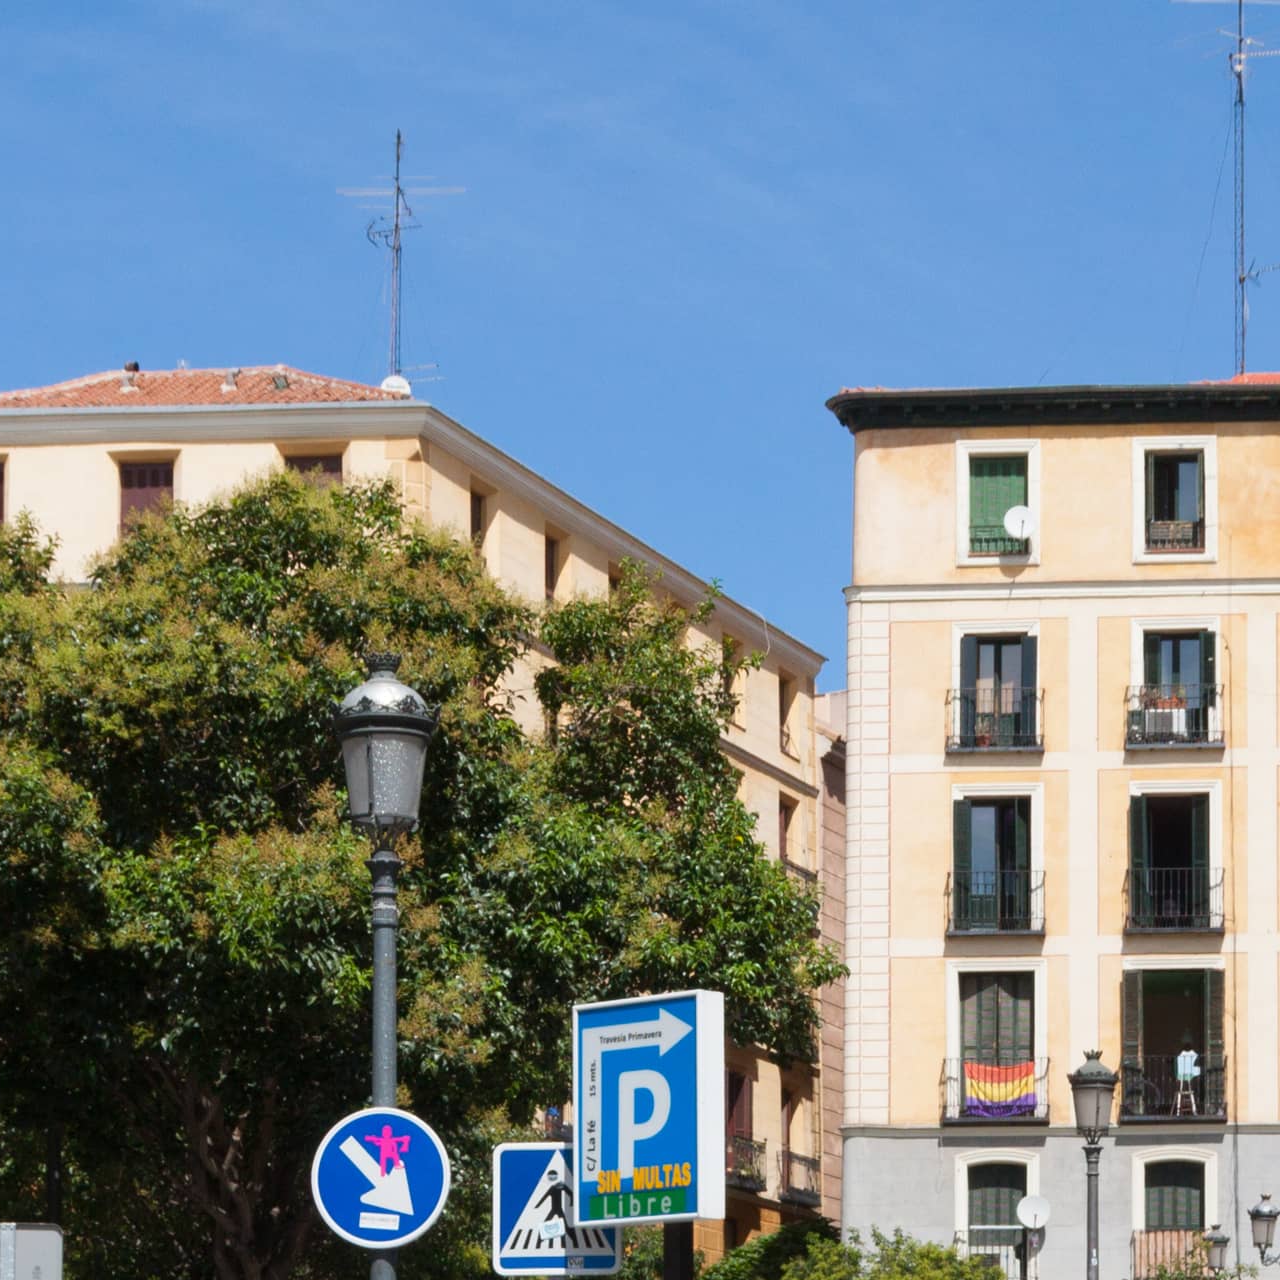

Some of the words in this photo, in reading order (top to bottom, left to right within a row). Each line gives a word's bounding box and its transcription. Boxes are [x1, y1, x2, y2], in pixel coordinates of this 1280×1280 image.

[628, 1030, 662, 1041] Primavera
[589, 1084, 596, 1097] 15
[618, 1069, 672, 1179] P
[587, 1137, 596, 1152] La
[597, 1169, 621, 1194] SIN
[633, 1162, 692, 1191] MULTAS
[604, 1193, 672, 1219] Libre
